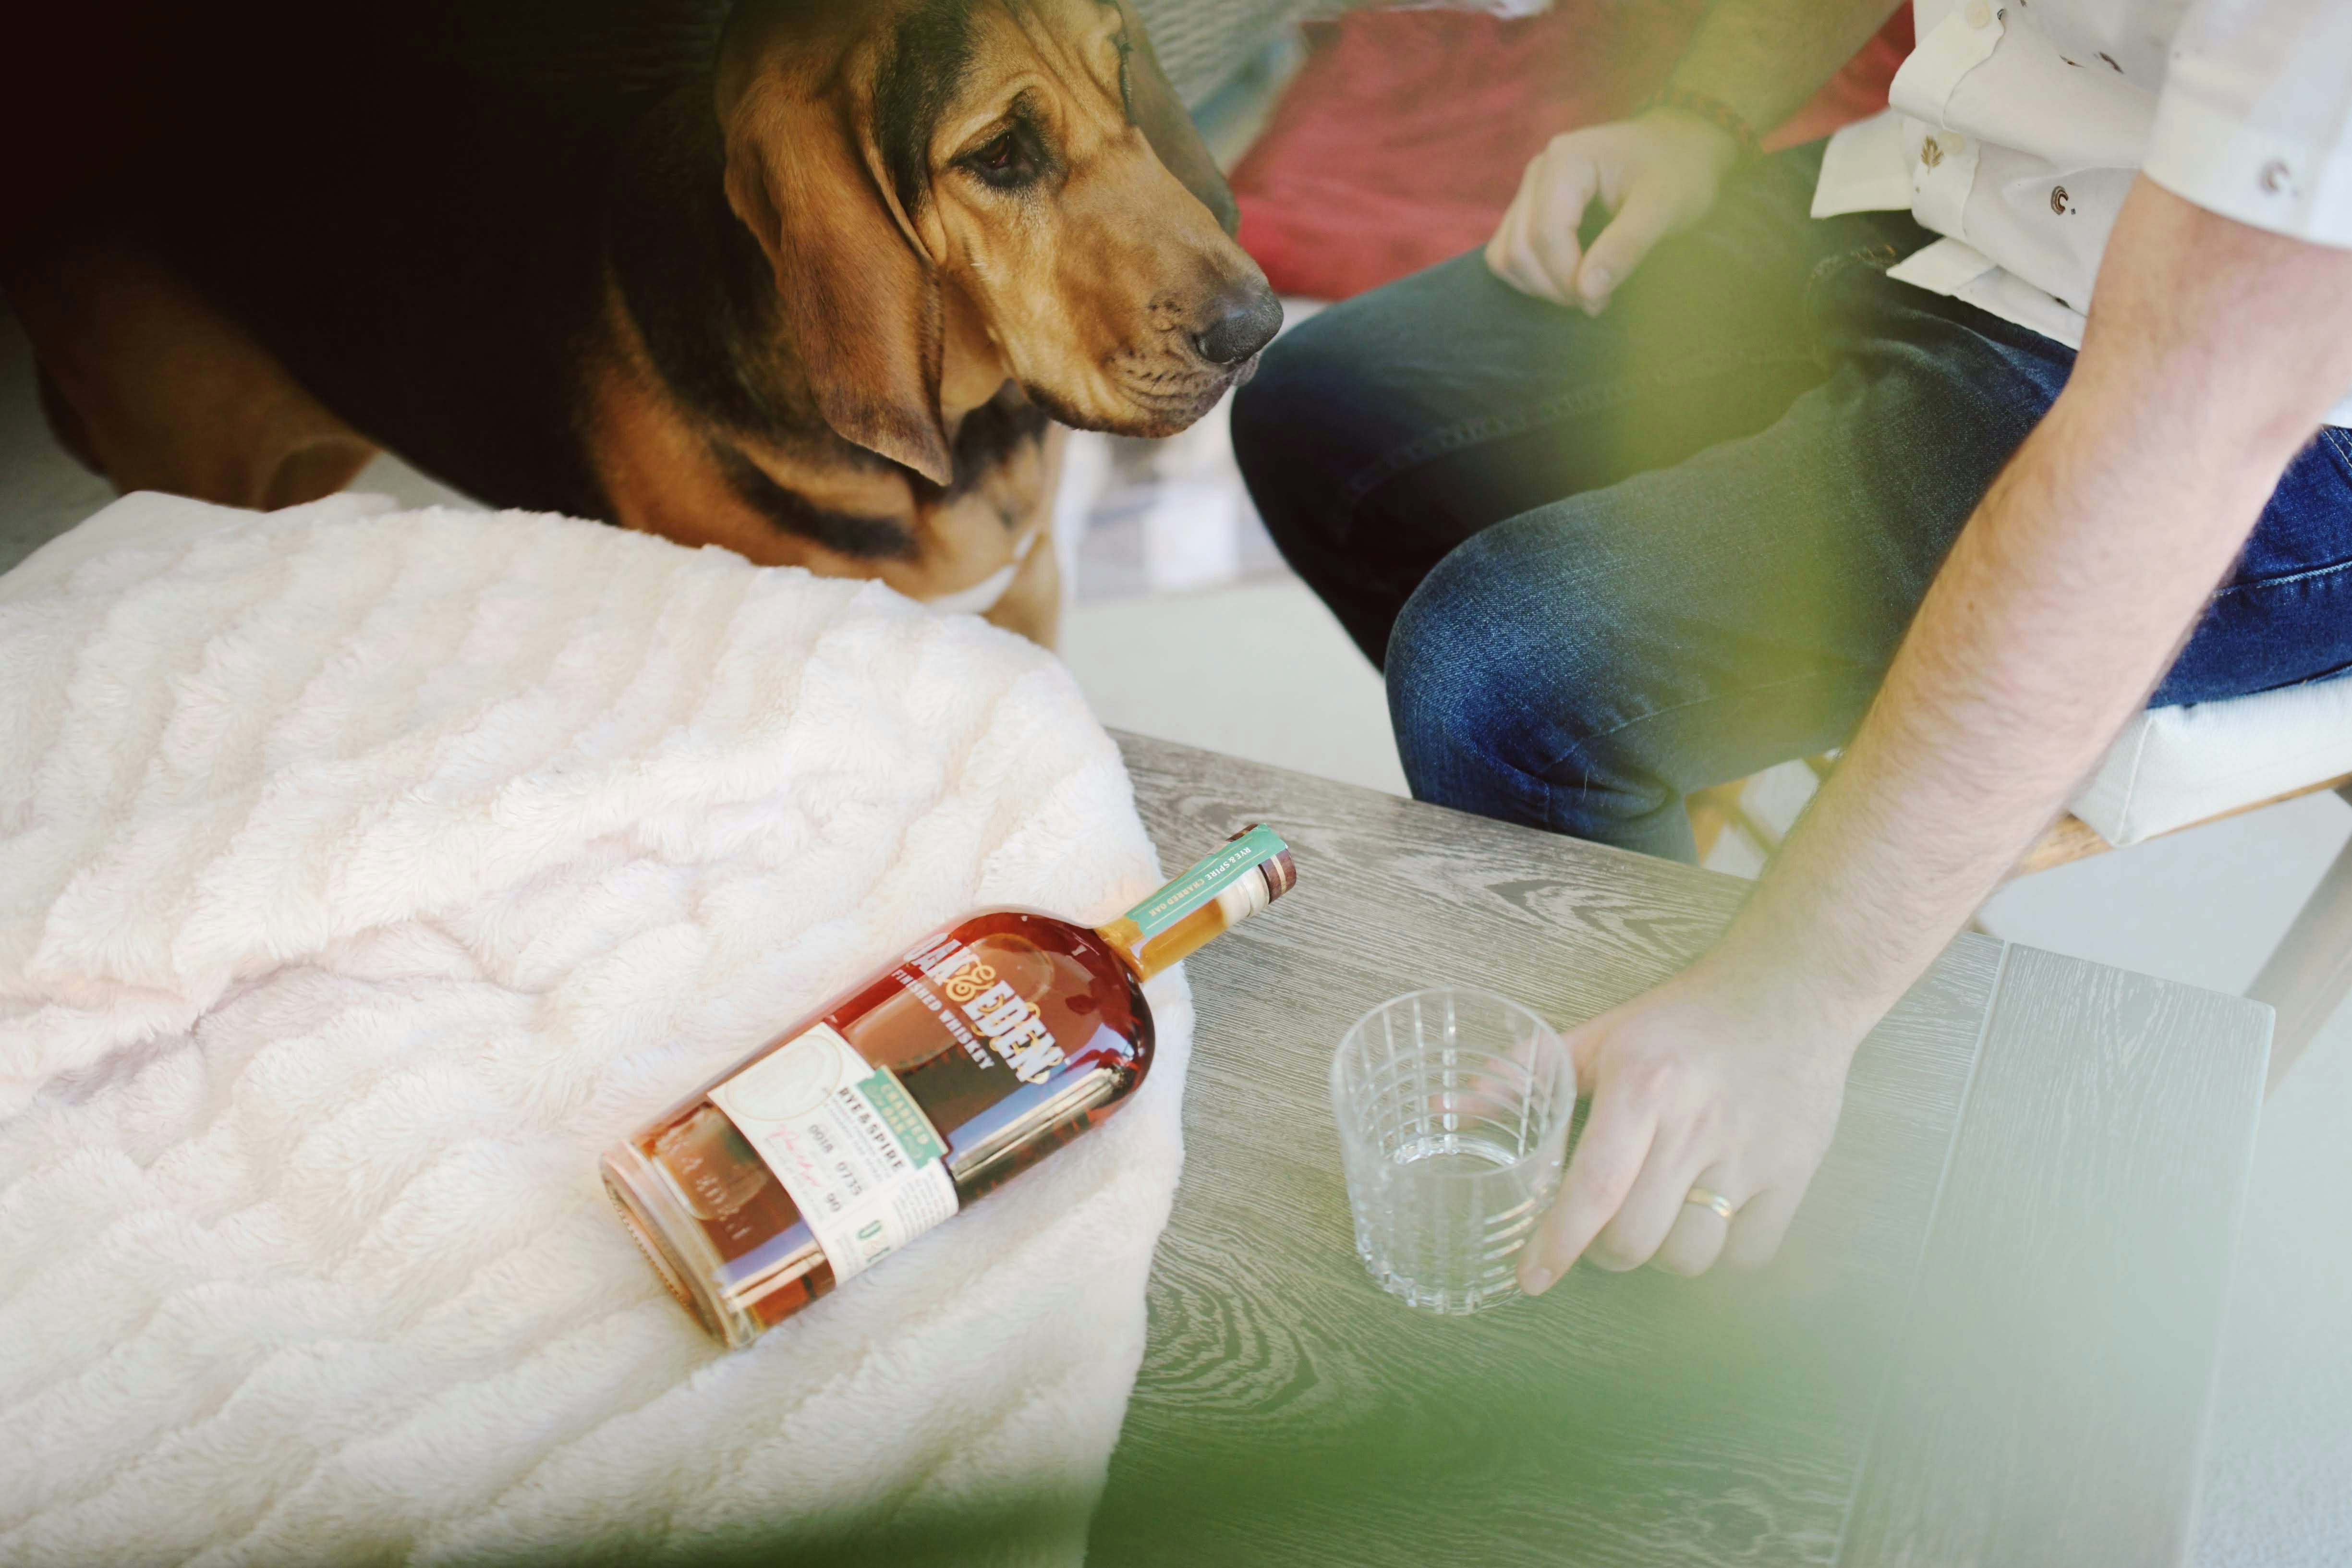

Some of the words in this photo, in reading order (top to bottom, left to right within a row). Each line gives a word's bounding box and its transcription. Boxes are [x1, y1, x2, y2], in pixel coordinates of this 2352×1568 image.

[1148, 903, 1167, 917] OAK
[1167, 878, 1205, 905] CHARRED
[903, 933, 980, 986] OAK
[945, 964, 996, 1002] &
[891, 969, 943, 1011] FINISHED
[939, 1009, 994, 1070] WHISKEY
[961, 980, 1066, 1082] EDEN
[880, 1083, 930, 1144] CHARRED
[882, 1106, 906, 1134] OAK
[826, 1192, 841, 1213] 90
